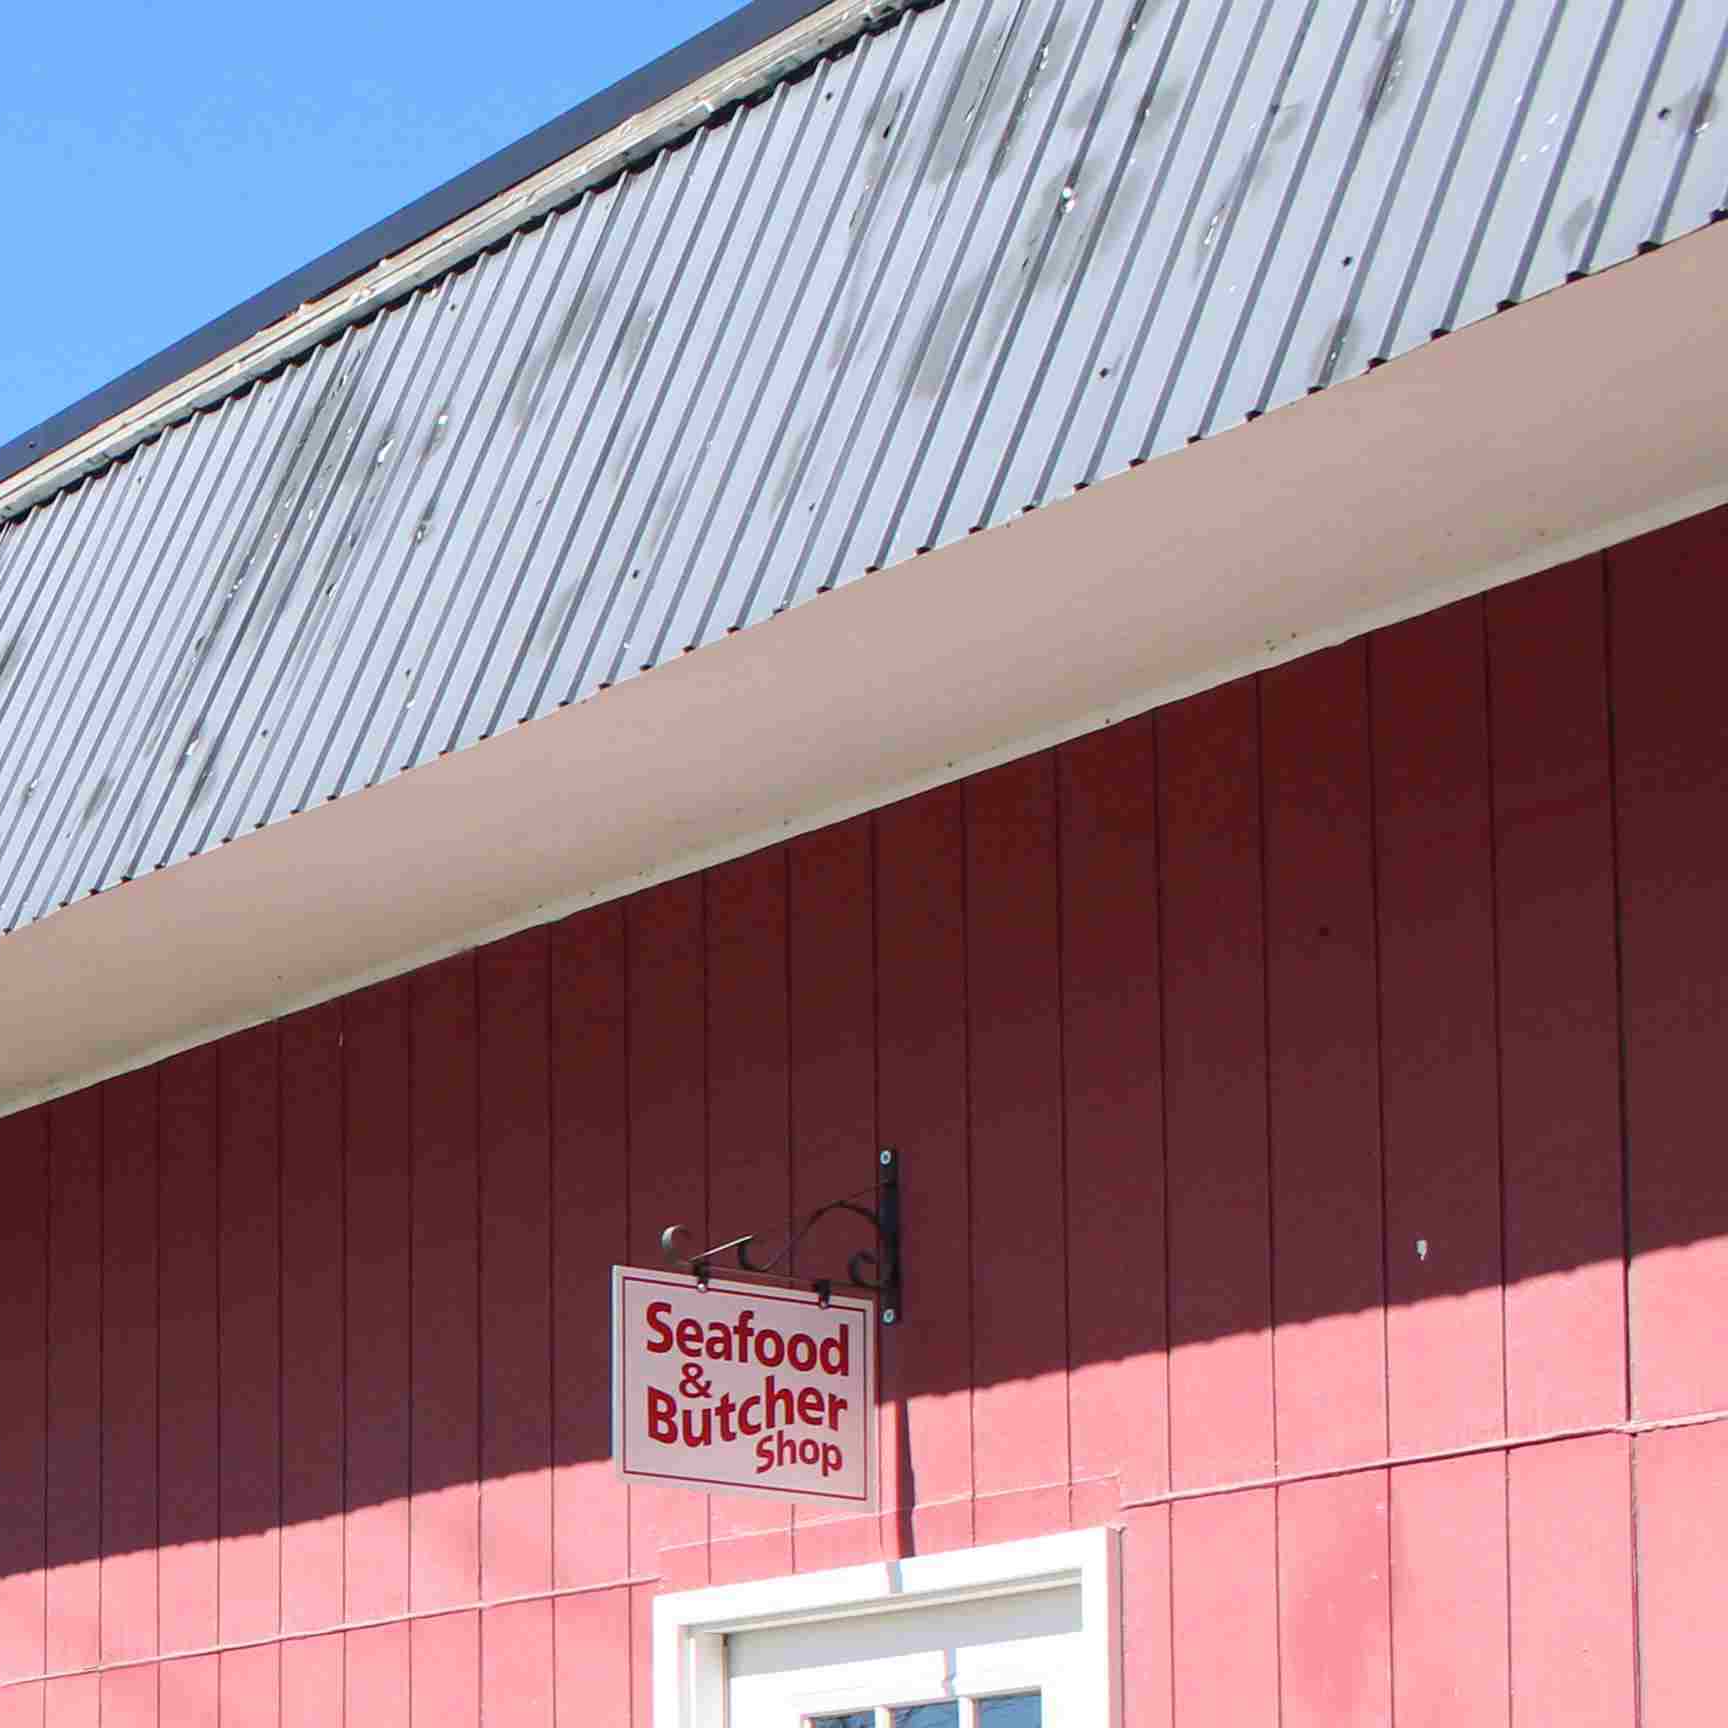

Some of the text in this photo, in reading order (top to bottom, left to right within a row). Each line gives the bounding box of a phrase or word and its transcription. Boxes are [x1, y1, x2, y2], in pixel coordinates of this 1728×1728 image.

[646, 1301, 849, 1376] Seafood
[679, 1362, 712, 1398] &
[647, 1375, 848, 1447] Butcher
[755, 1430, 843, 1477] Shop
